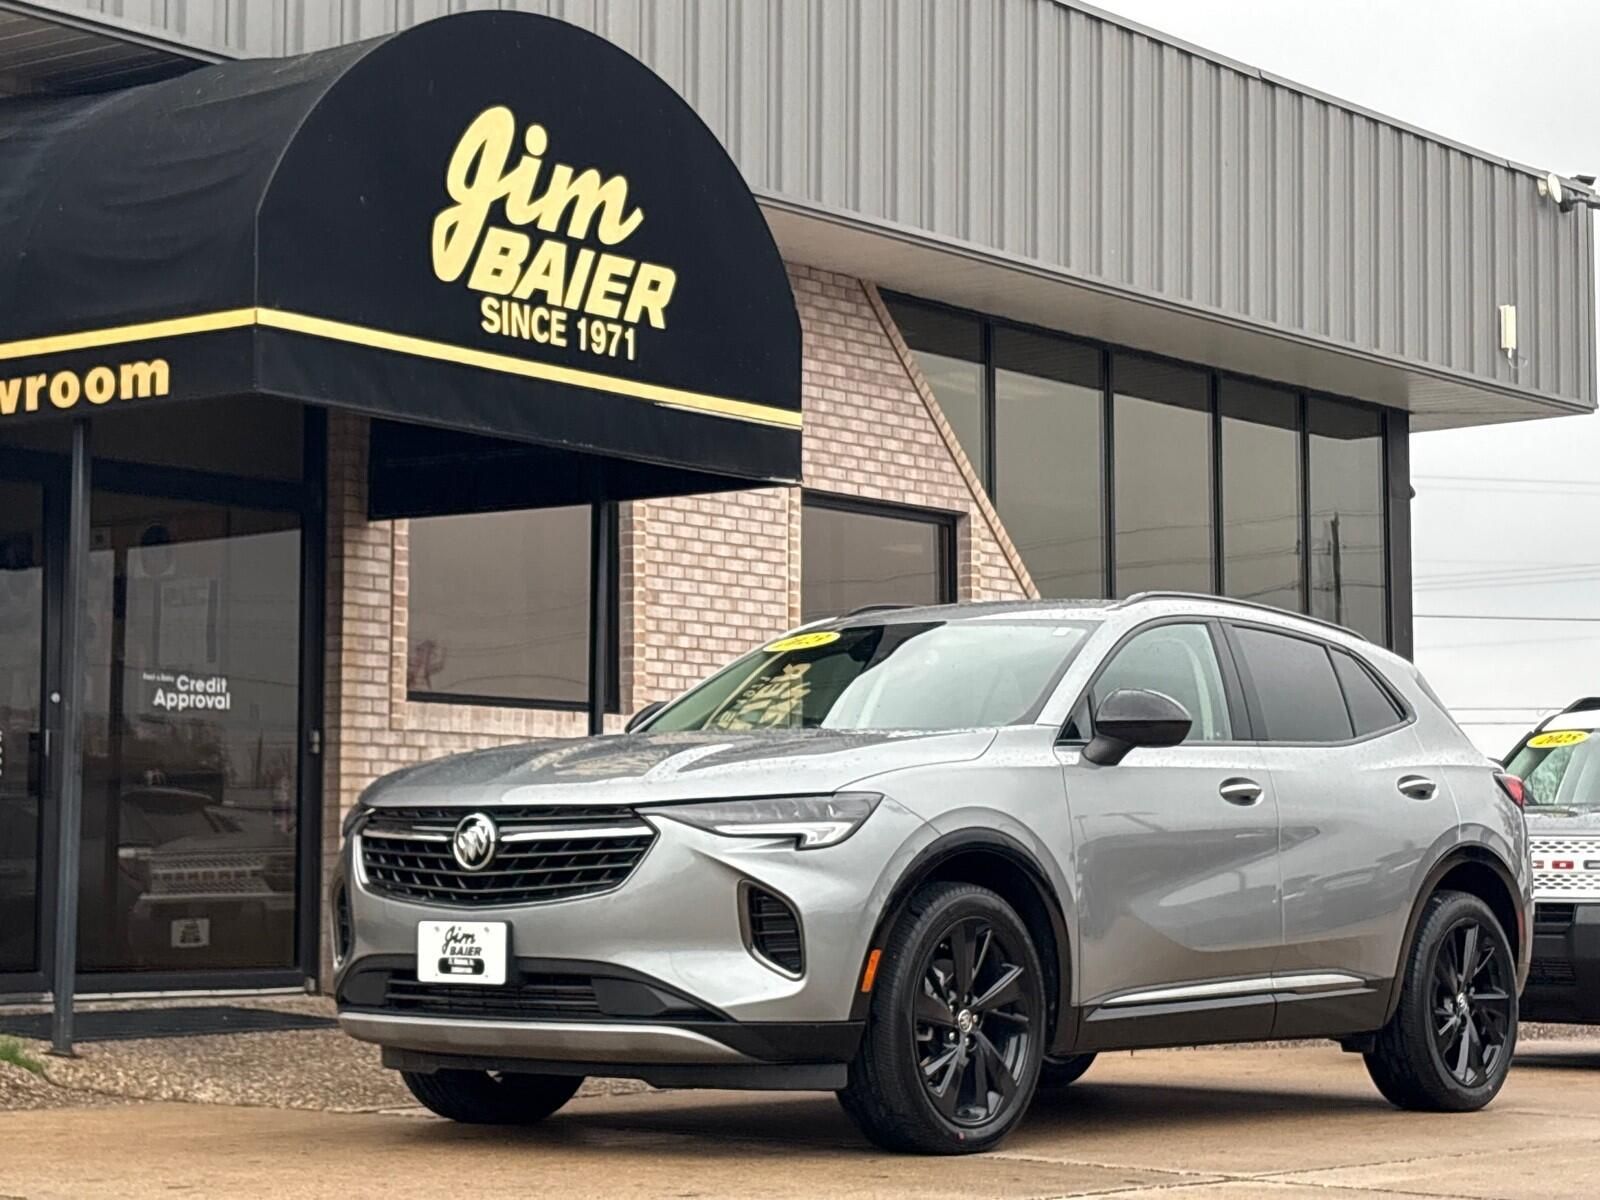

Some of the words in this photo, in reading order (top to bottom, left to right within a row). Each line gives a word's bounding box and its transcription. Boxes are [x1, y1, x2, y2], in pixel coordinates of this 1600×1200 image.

[431, 105, 644, 282] Jim
[467, 226, 677, 330] BAIER
[480, 296, 567, 347] SINCE
[576, 317, 636, 361] 1971
[176, 674, 227, 693] Credit
[153, 687, 231, 711] Approval
[442, 925, 476, 955] Jim
[449, 946, 482, 956] BAIER
